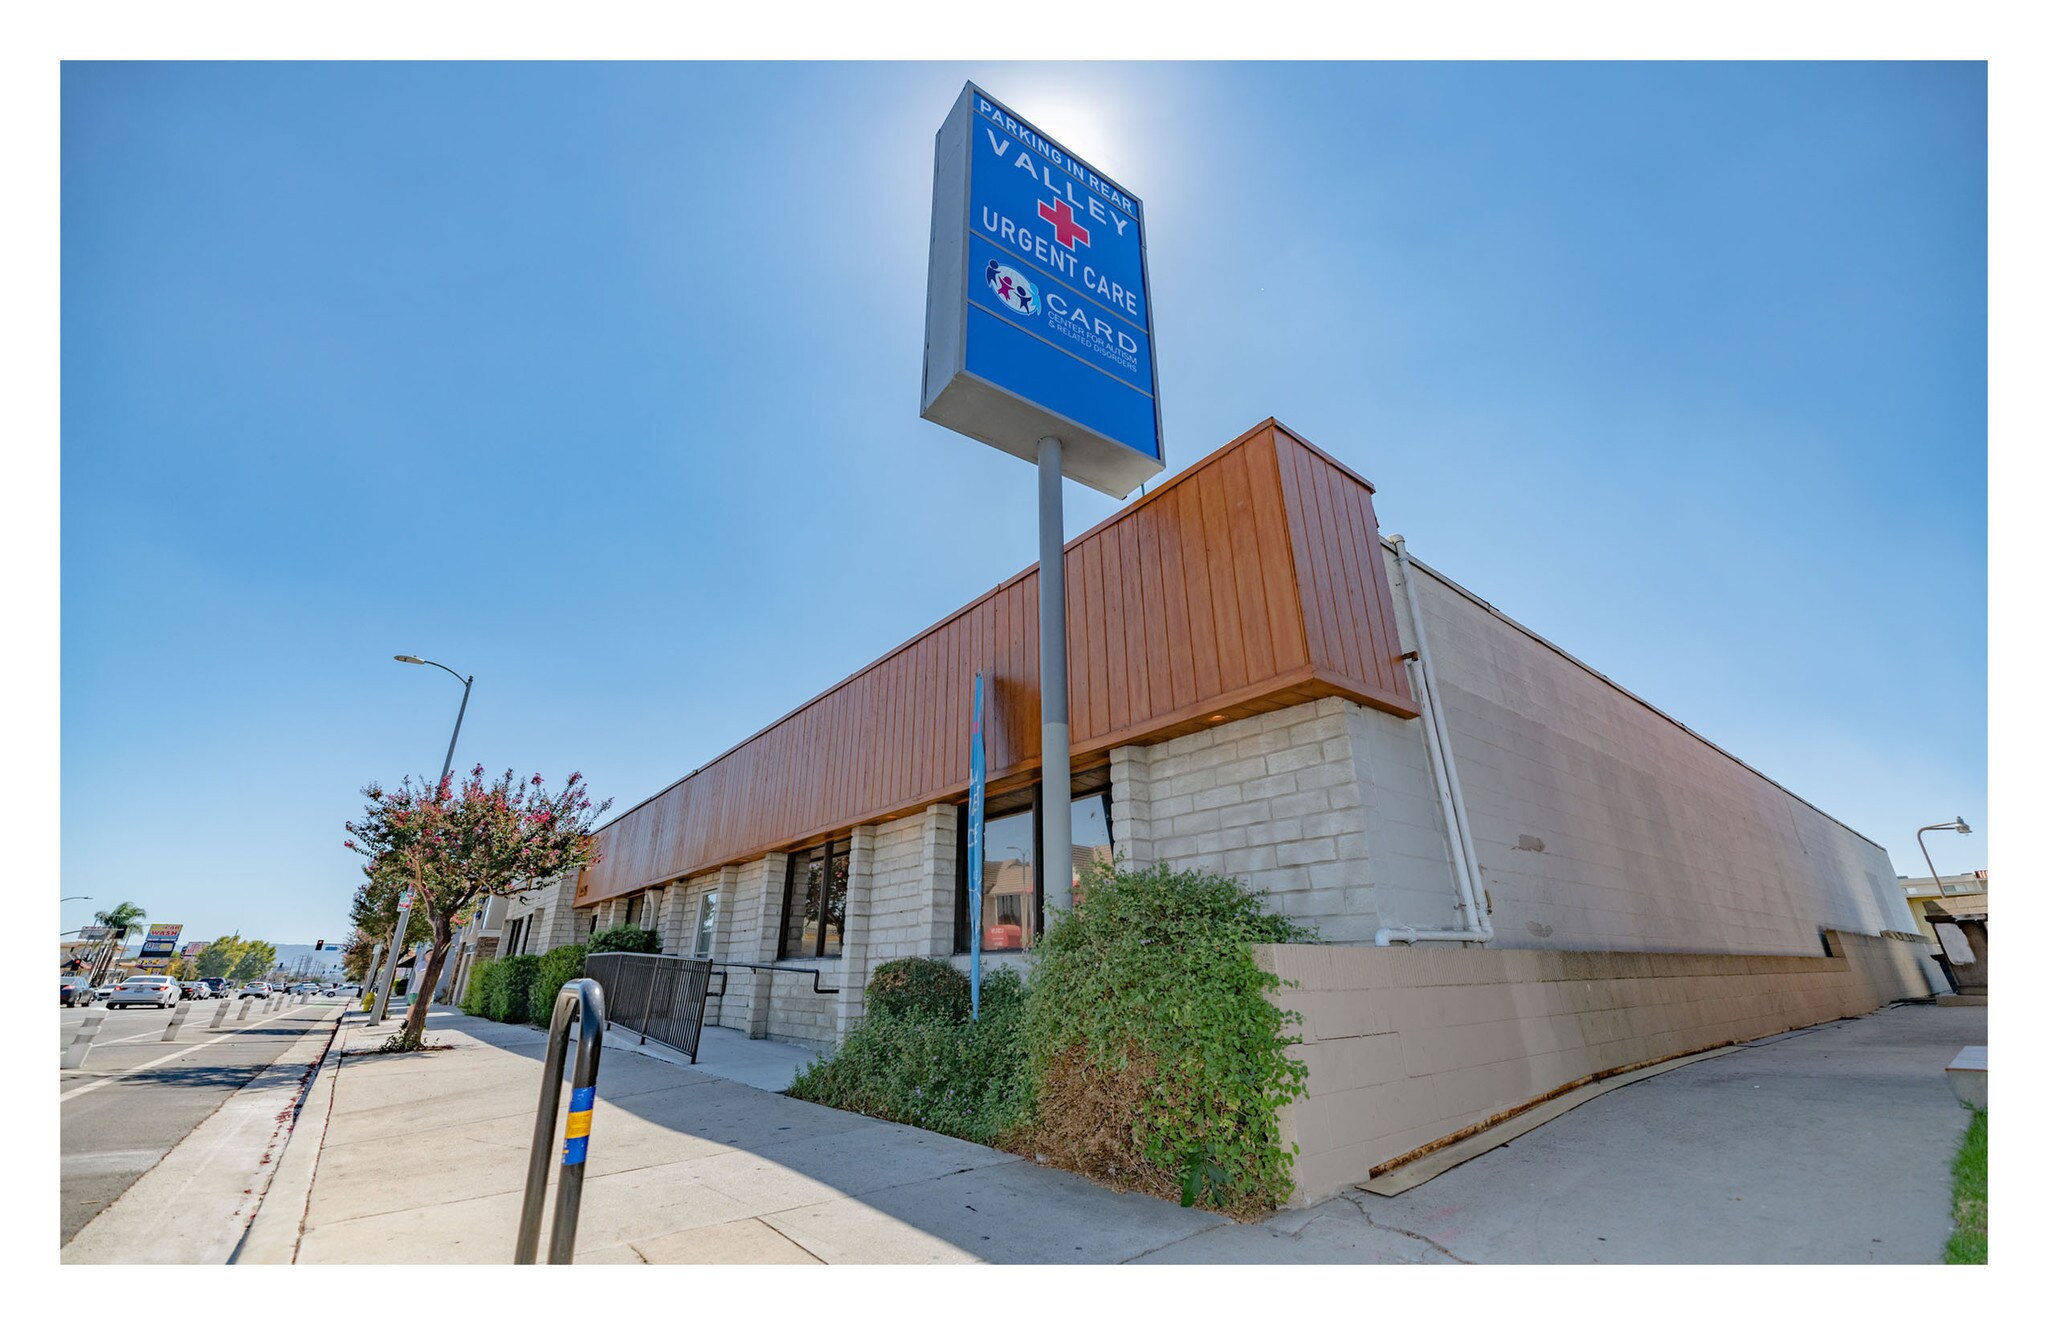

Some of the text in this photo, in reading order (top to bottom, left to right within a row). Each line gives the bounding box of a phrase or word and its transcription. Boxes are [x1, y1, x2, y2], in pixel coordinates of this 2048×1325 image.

[980, 98, 1132, 212] PARKING IN REAR
[986, 128, 1128, 236] VALLEY
[983, 206, 1137, 316] URGENT CARE
[1047, 293, 1137, 354] CARD
[1047, 311, 1137, 365] CENTER FOR AUTISM
[1048, 319, 1137, 373] & RELATED DISORDERS
